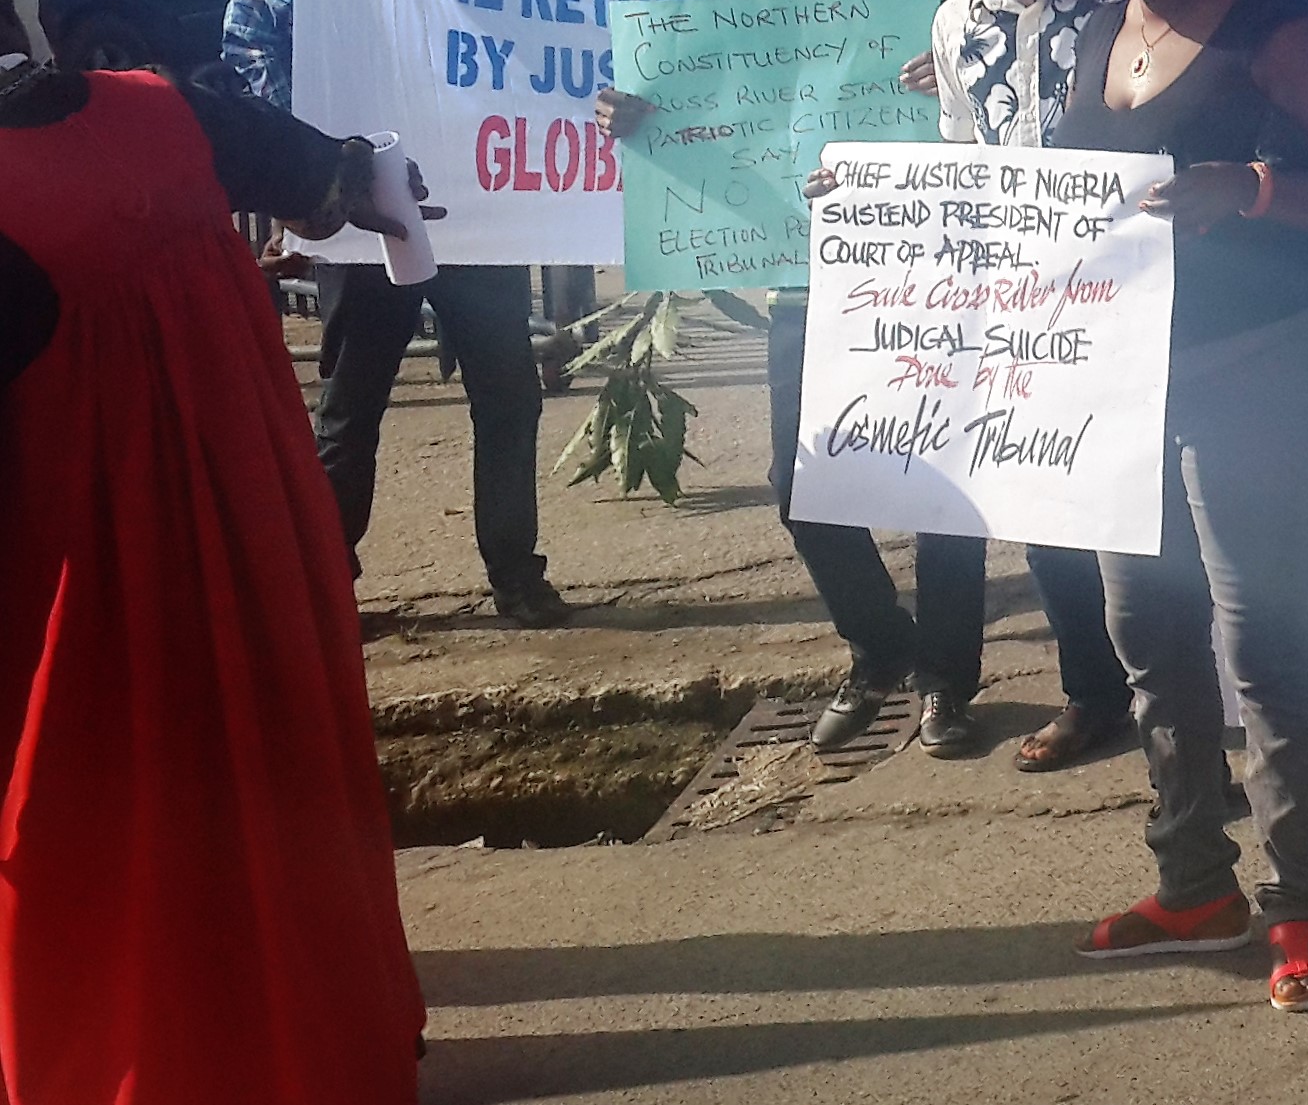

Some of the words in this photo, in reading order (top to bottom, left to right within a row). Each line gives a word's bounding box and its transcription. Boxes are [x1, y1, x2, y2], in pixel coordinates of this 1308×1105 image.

[624, 11, 699, 37] THE
[712, 0, 871, 30] NORTHERN
[445, 30, 515, 91] BY
[633, 37, 848, 82] CONSTITUENCY
[736, 83, 816, 108] RIVER
[647, 117, 774, 156] PATRIOTIC
[792, 106, 929, 135] CITIZENS
[475, 114, 623, 193] GLOB
[730, 140, 801, 171] SAY
[664, 177, 750, 223] NO
[833, 158, 892, 191] CHIEF
[895, 162, 990, 193] JUSTICE
[1000, 165, 1028, 196] OF
[1034, 167, 1126, 205] NIGERIA
[659, 222, 768, 257] ELECTION
[821, 203, 932, 229] SUSTEND
[941, 201, 1069, 238] PRESIDENT
[1074, 214, 1115, 239] OF
[696, 249, 809, 280] TRIBUNAL
[820, 235, 896, 268] COURT
[897, 240, 926, 263] OF
[934, 236, 1040, 274] APPEAL.
[1048, 258, 1120, 328] from
[979, 323, 1094, 365] SUICIDE
[826, 394, 951, 475] Cosmetic
[963, 407, 1094, 478] Tribunal
